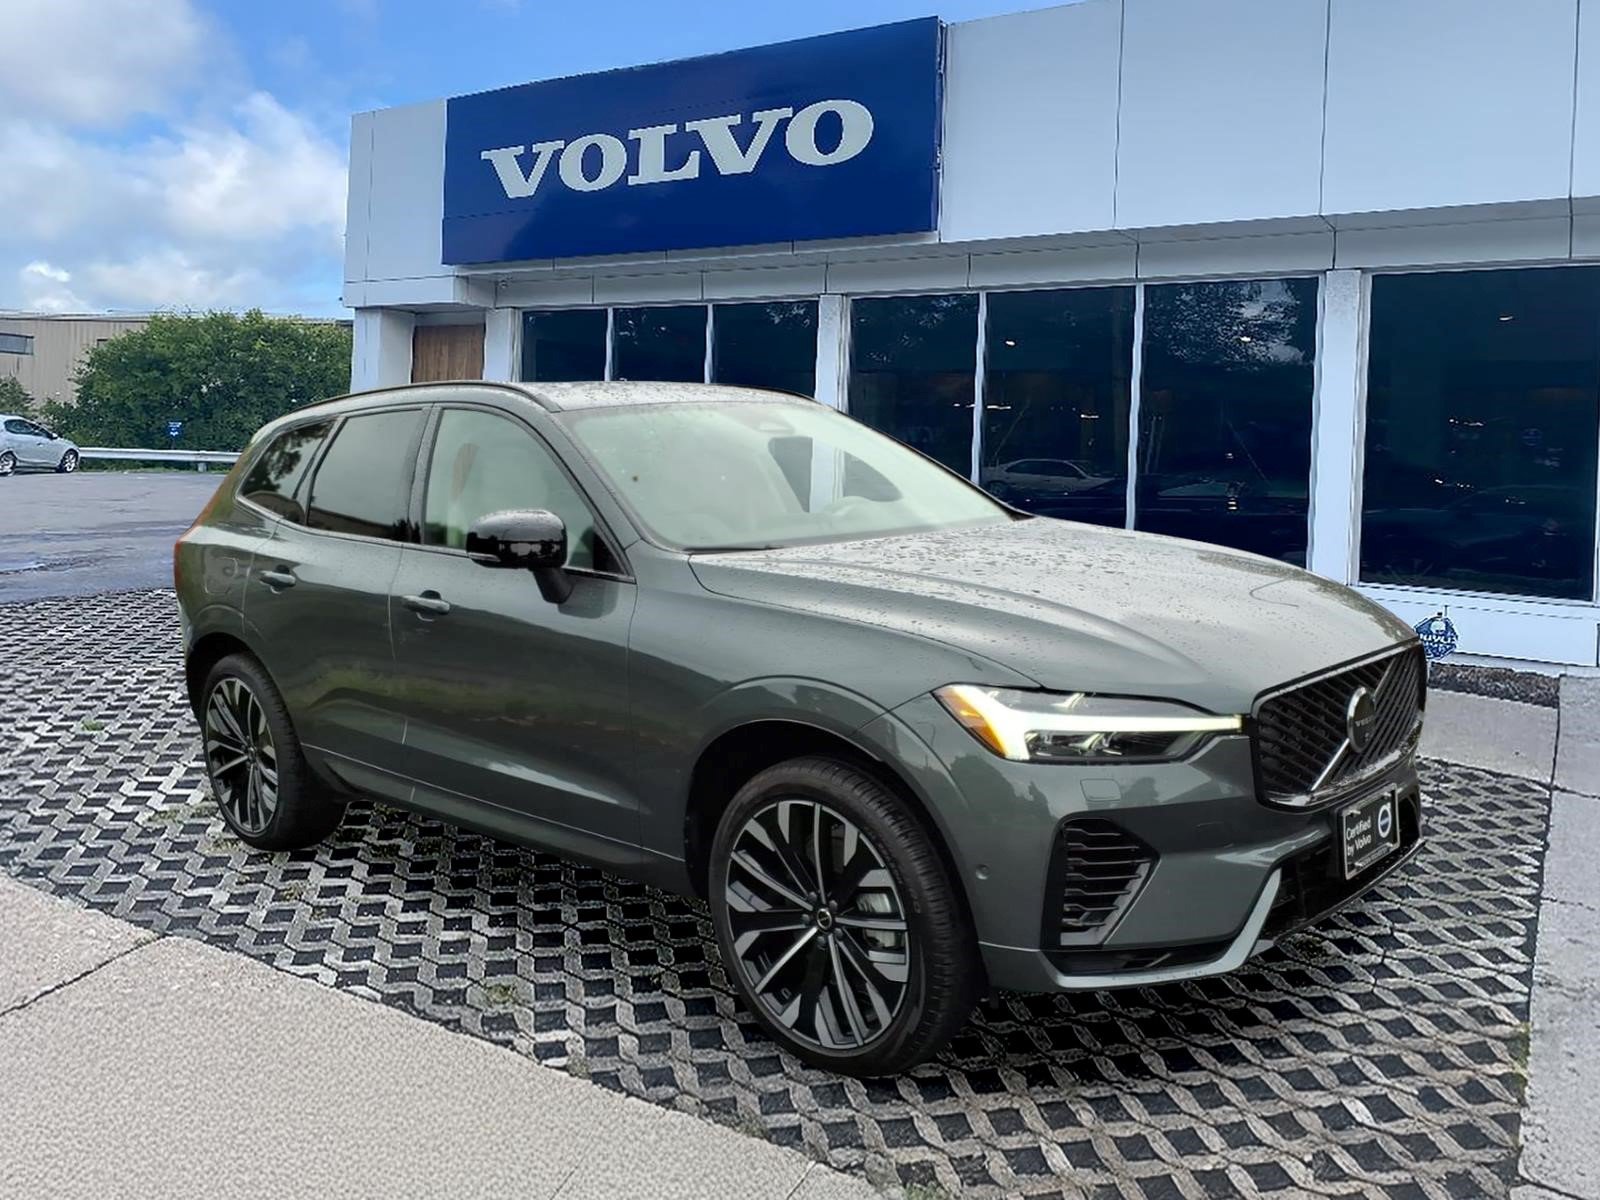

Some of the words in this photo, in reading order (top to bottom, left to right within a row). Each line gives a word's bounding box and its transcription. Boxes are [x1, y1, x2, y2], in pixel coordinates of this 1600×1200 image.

[481, 99, 874, 198] VOLVO
[1346, 816, 1371, 840] Certified
[1347, 844, 1354, 856] by
[1355, 834, 1371, 849] Volvo
